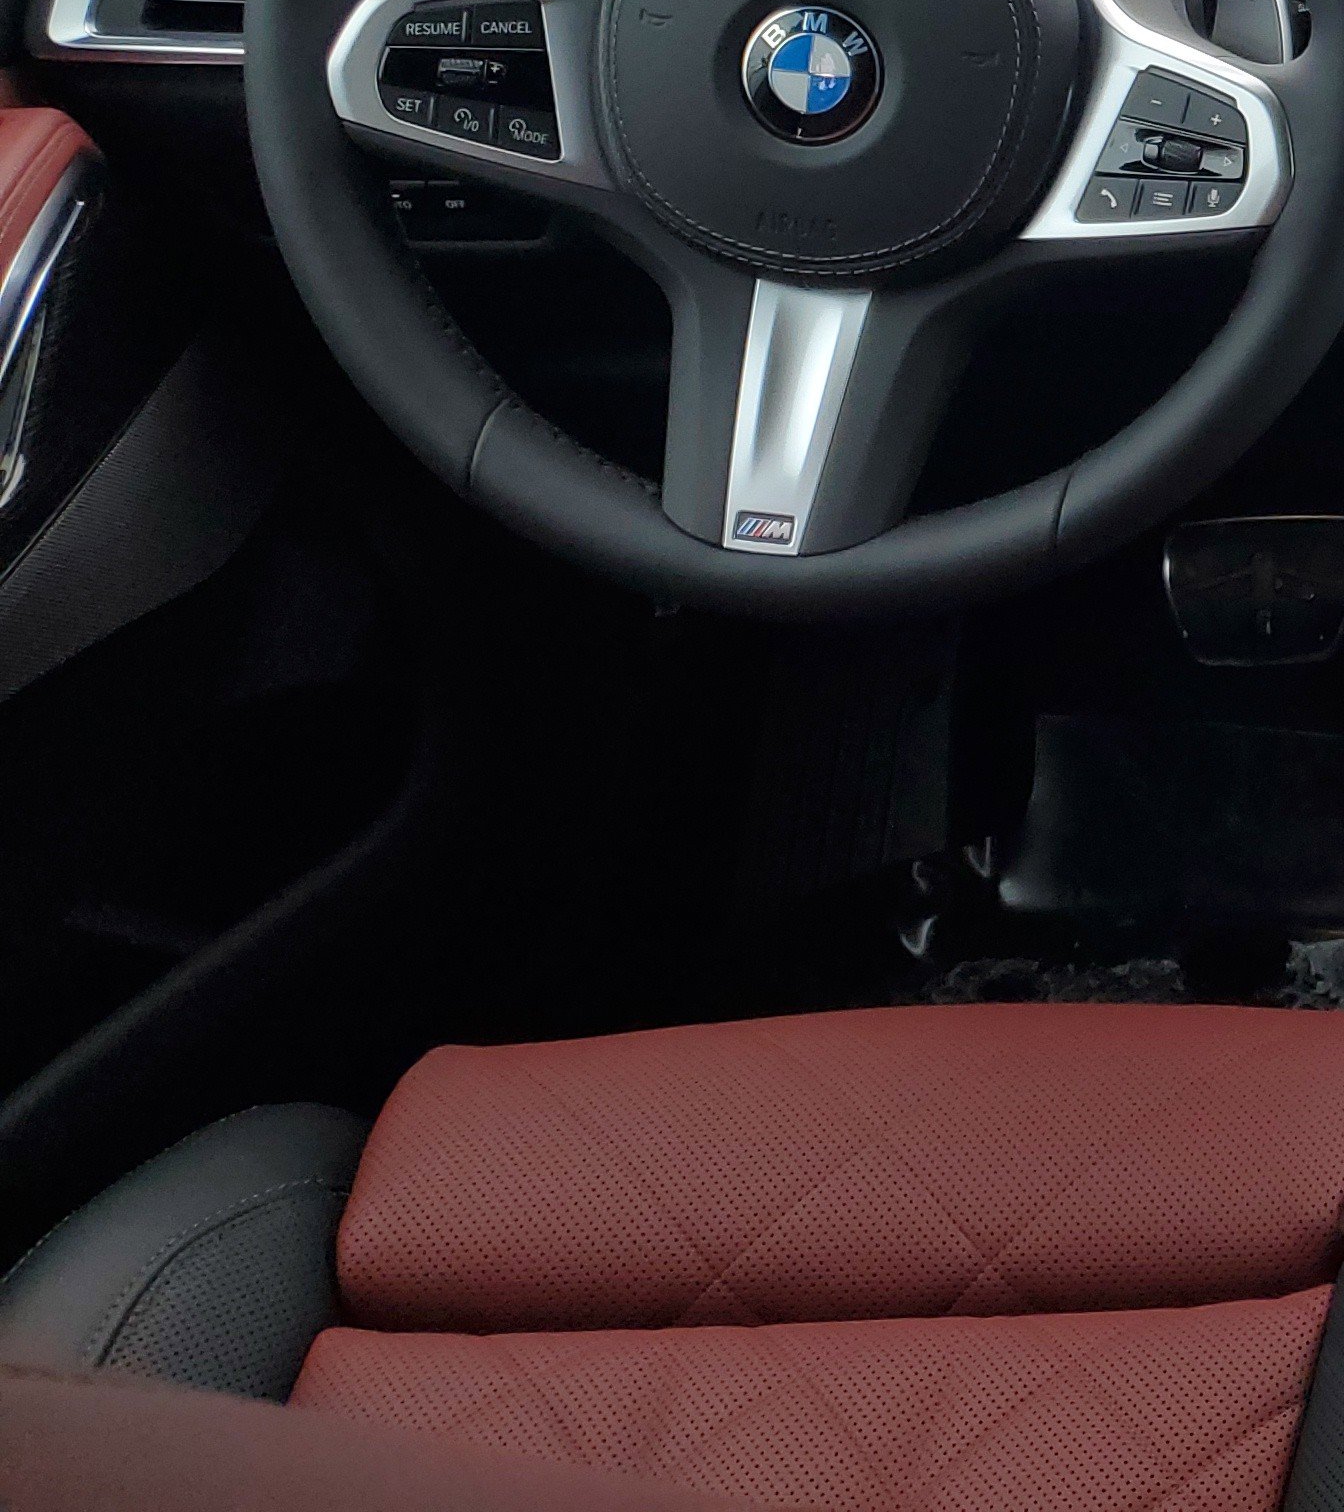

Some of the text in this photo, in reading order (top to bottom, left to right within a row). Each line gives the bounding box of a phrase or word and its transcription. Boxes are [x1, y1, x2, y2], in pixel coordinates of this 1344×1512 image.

[405, 22, 461, 36] RESUME
[480, 21, 532, 34] CANCEL
[761, 11, 868, 57] BMW
[396, 97, 422, 113] SET
[513, 129, 549, 145] MODE
